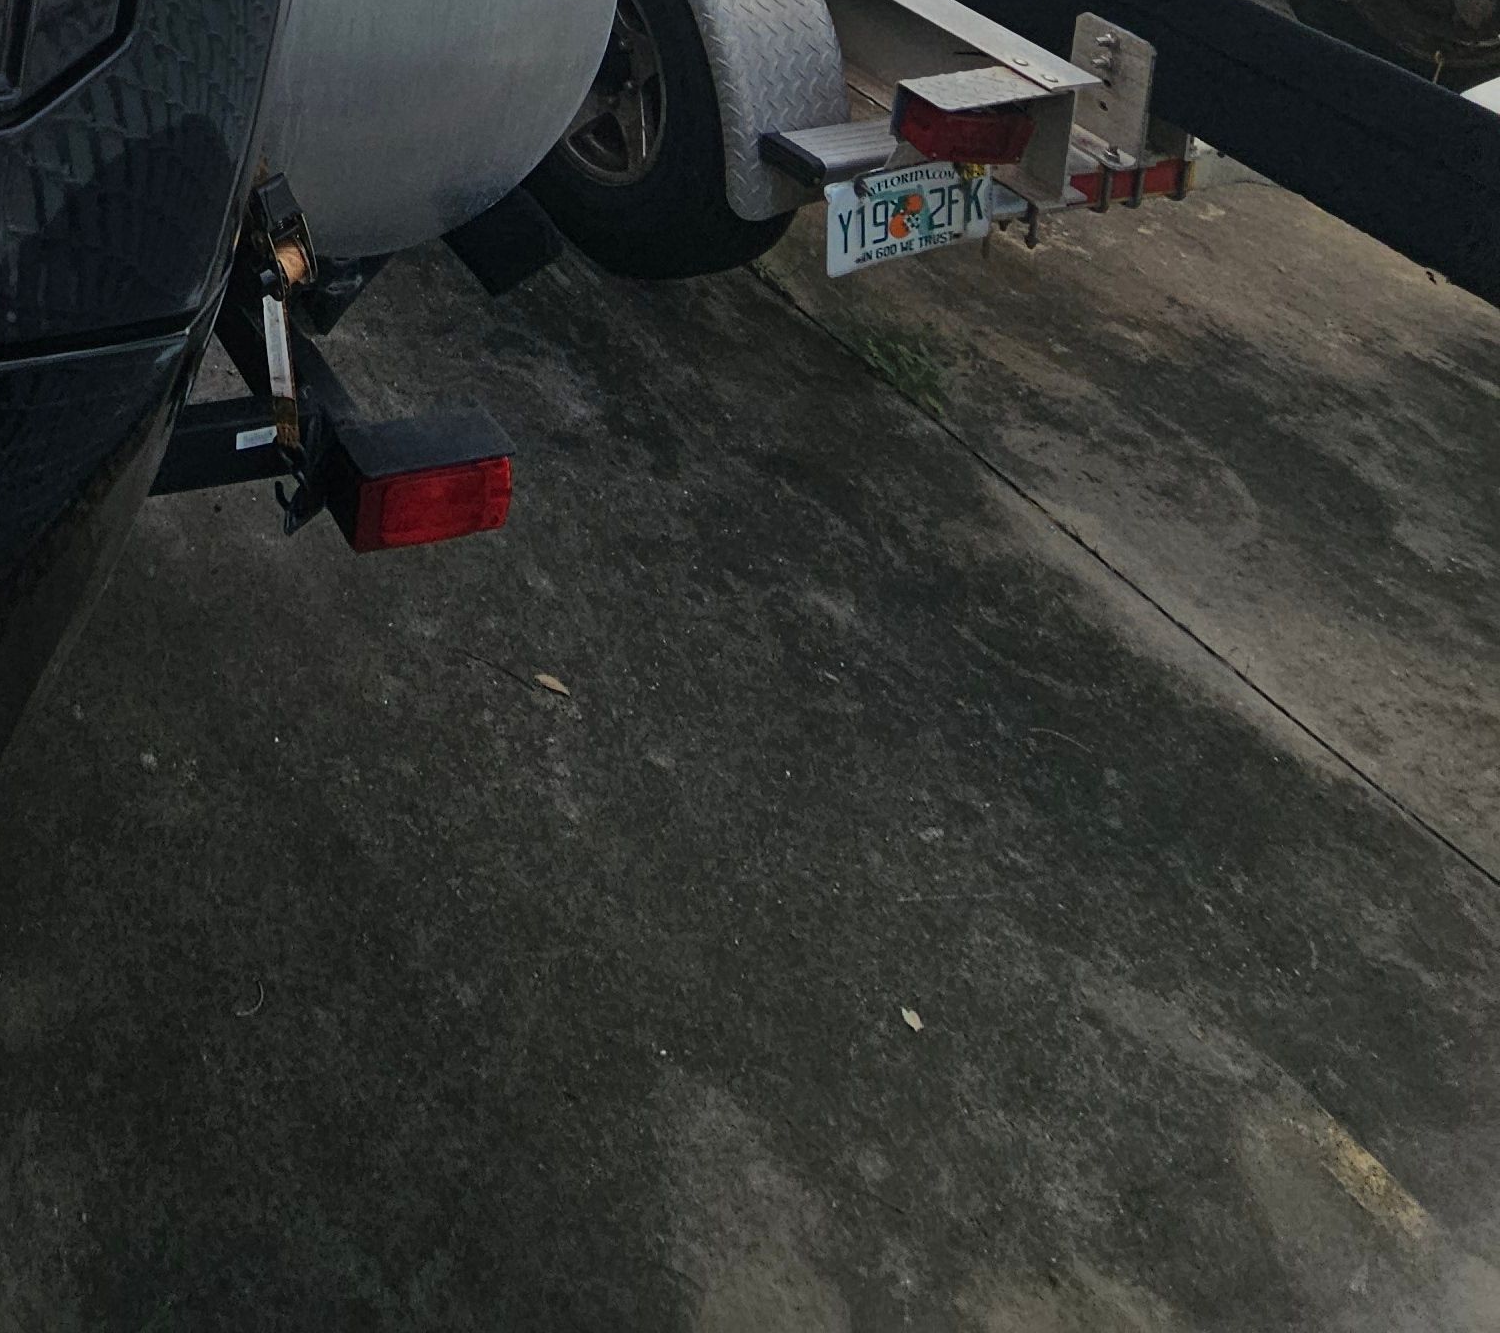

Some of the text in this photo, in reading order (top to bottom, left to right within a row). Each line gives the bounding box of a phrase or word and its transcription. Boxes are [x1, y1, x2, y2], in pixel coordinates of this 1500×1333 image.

[875, 242, 898, 260] GOD
[900, 239, 915, 252] WE
[918, 230, 954, 249] TRUST
